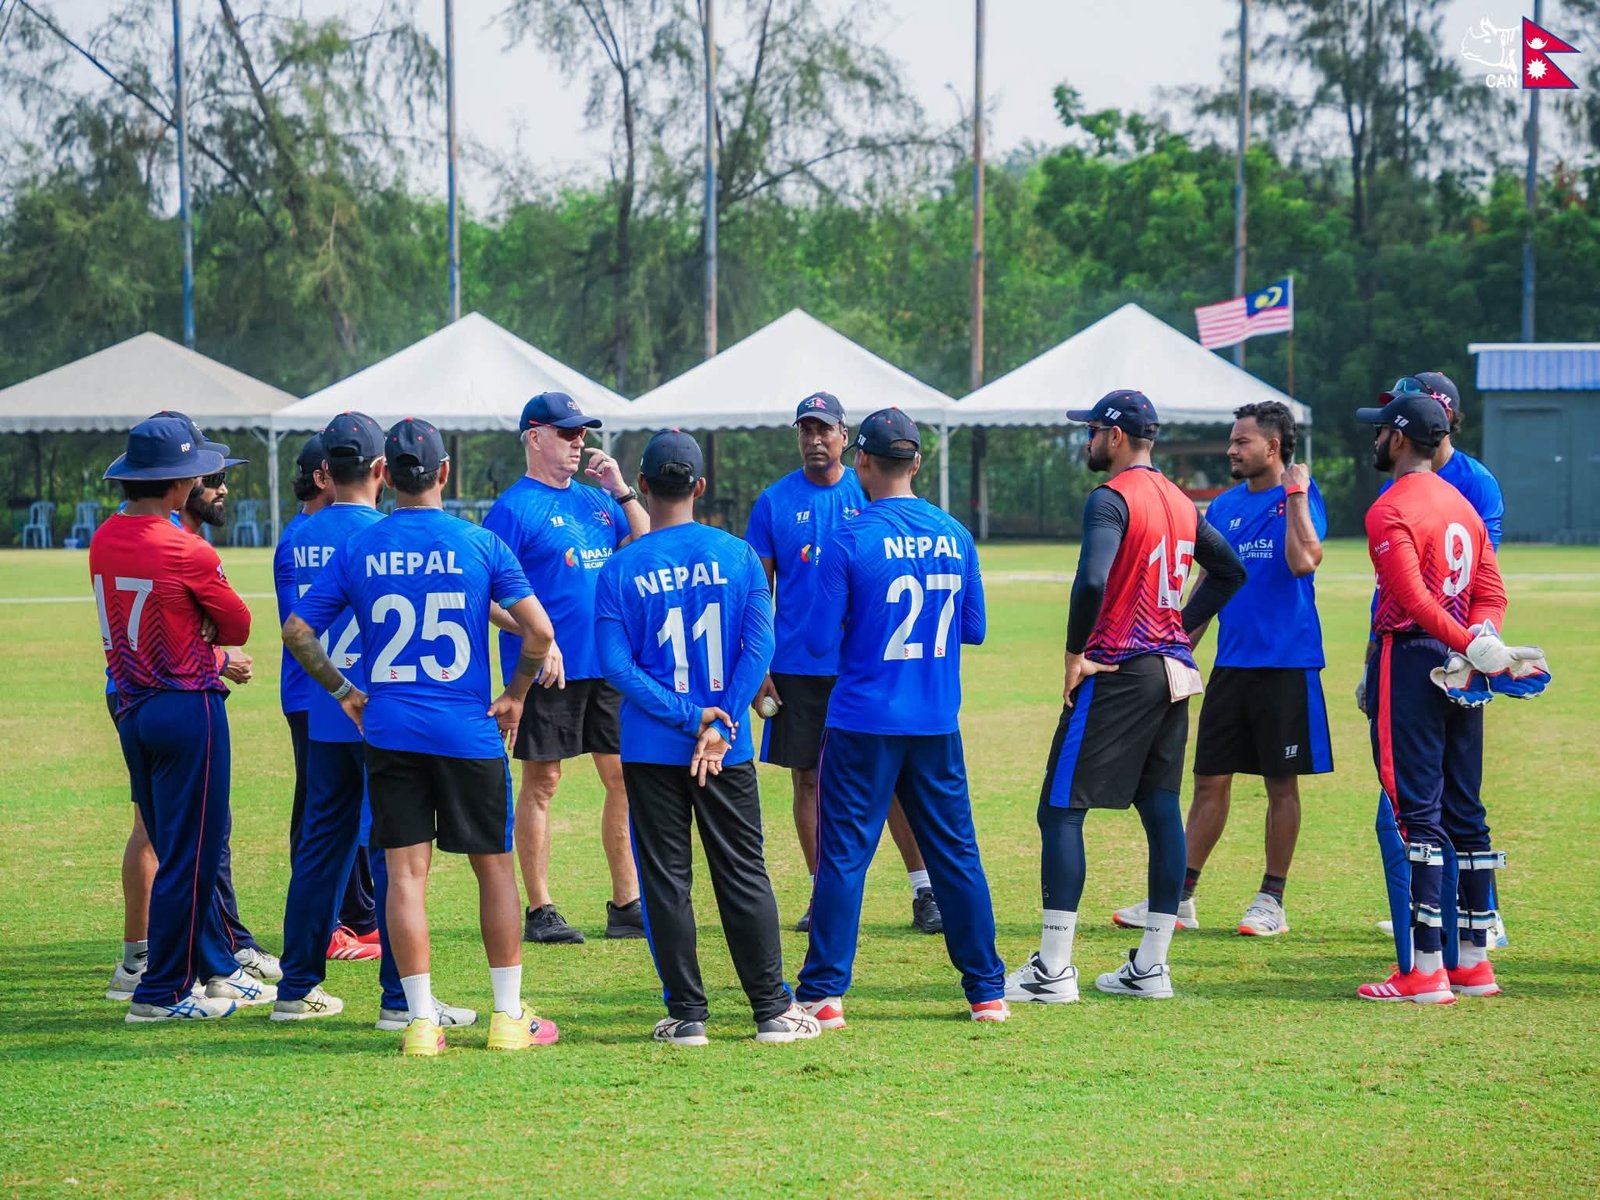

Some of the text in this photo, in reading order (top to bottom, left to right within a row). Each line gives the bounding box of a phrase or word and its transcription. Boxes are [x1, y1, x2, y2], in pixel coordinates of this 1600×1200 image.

[365, 550, 464, 577] NEPAL
[580, 547, 614, 560] NAASA
[633, 561, 729, 598] NEPAL
[883, 535, 962, 560] NEPAL
[1148, 535, 1195, 612] 15
[1442, 522, 1473, 597] 9
[93, 573, 154, 652] 17
[370, 591, 472, 683] 25
[656, 602, 724, 694] 11
[883, 573, 962, 661] 27
